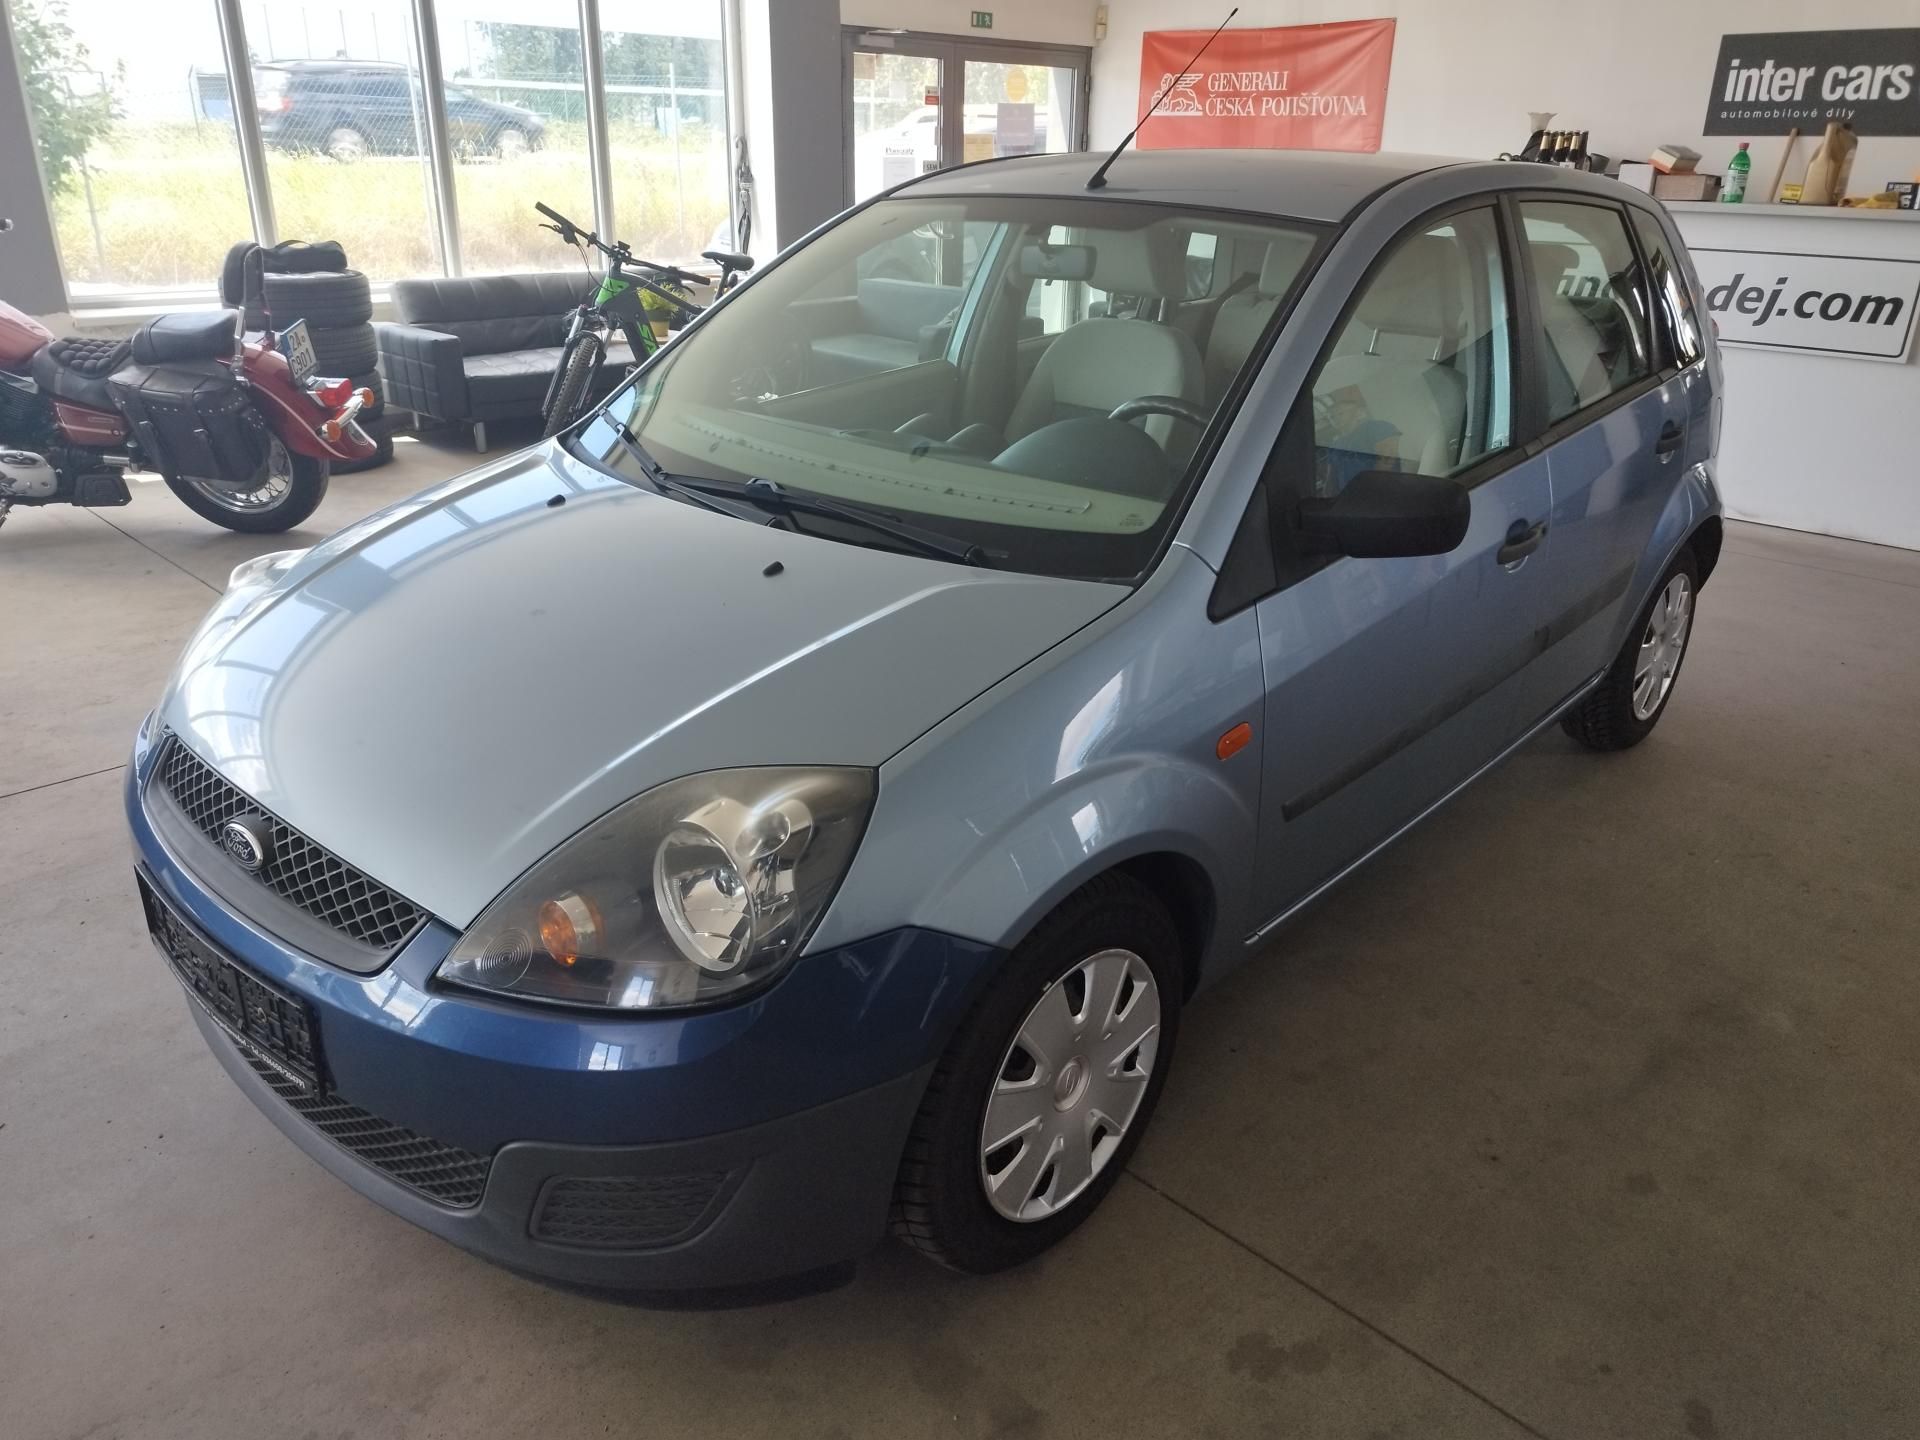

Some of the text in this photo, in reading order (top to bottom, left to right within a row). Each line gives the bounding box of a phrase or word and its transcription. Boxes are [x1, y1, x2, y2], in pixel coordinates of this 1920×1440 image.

[1207, 70, 1289, 92] GENERALI
[1724, 58, 1915, 102] inter cars
[1205, 91, 1368, 117] ČESKÁ POJIŠŤOVNA
[1720, 108, 1819, 119] automobilové
[289, 331, 302, 352] 2A
